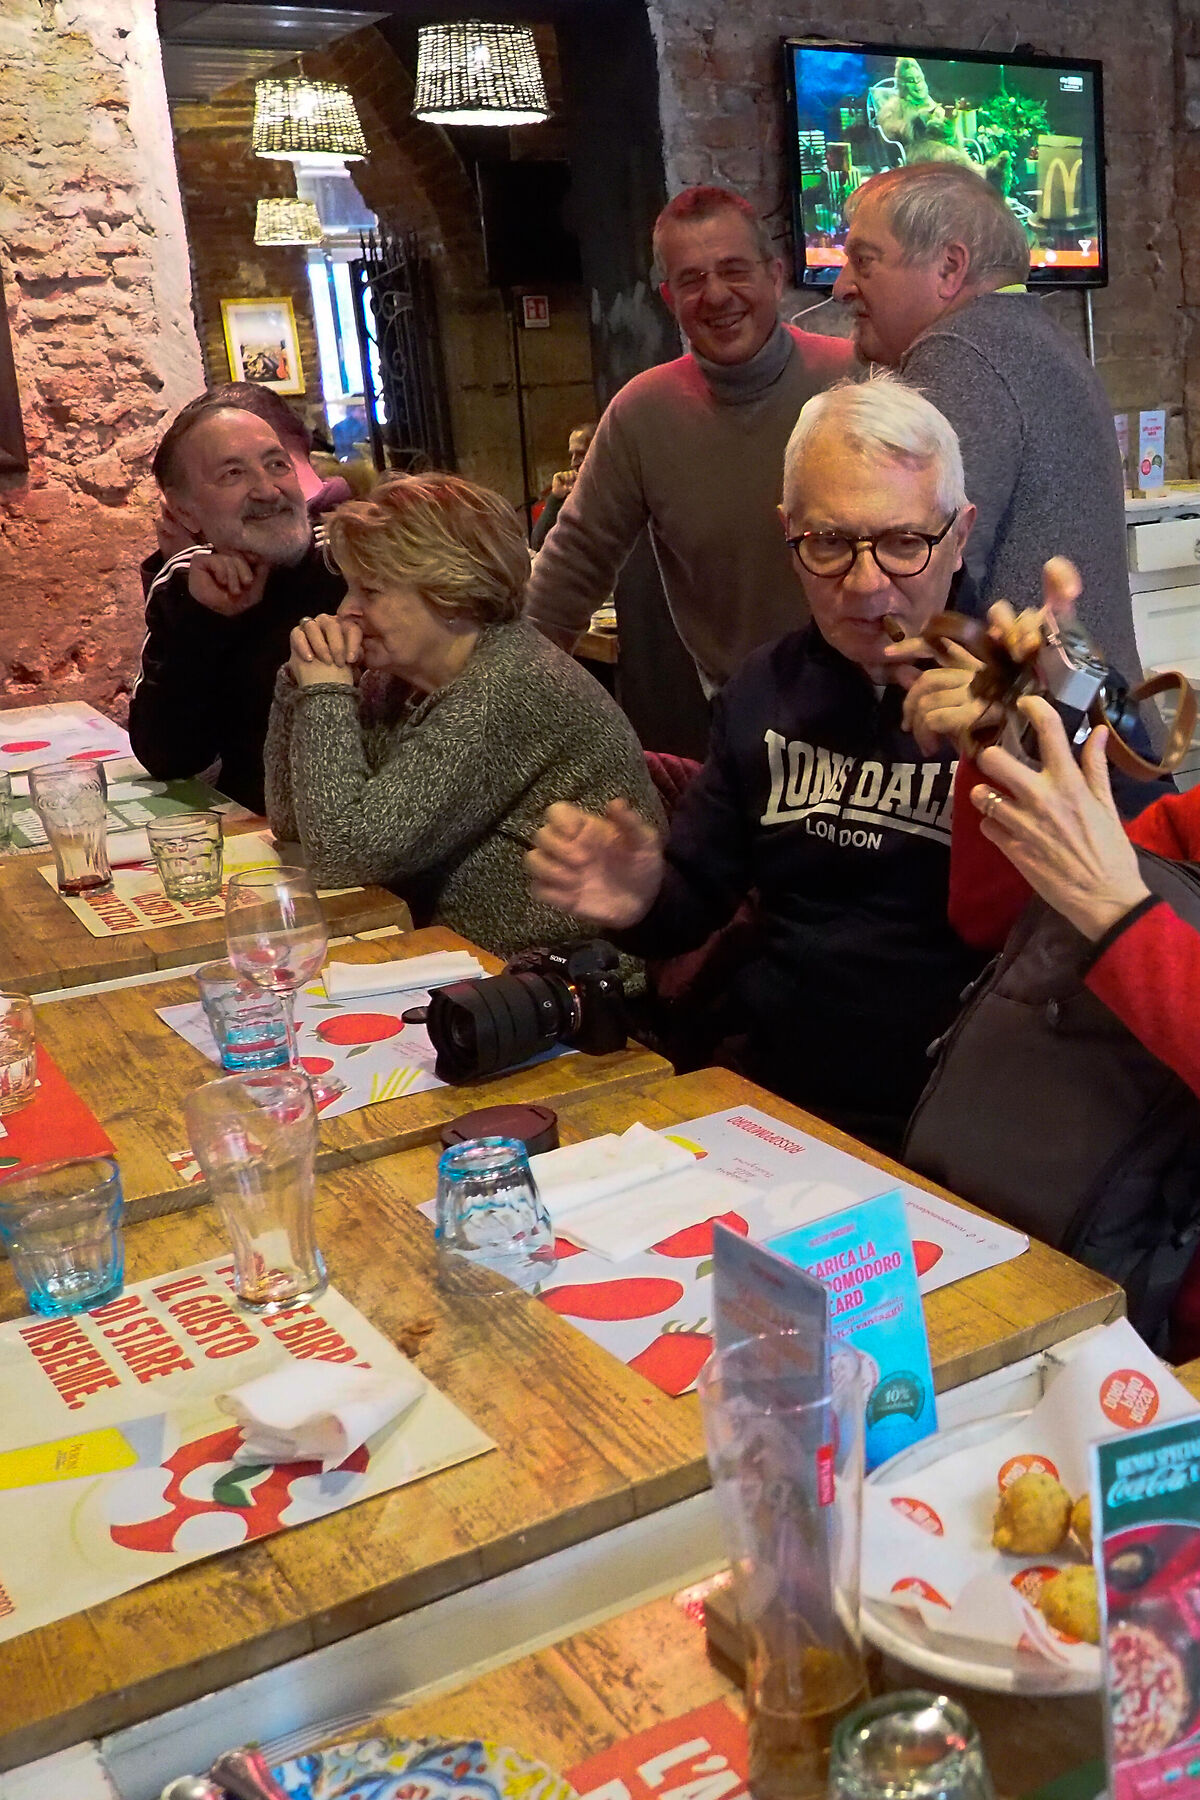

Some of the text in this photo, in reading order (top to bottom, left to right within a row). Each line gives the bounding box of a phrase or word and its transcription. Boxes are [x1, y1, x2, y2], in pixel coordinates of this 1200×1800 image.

[805, 817, 884, 851] LONDON
[130, 892, 180, 917] GUSTO
[549, 954, 567, 964] SONY
[806, 1250, 858, 1281] CARICA
[858, 1240, 876, 1261] LA
[152, 1275, 208, 1302] IL
[88, 1295, 196, 1384] DI STARE
[168, 1293, 261, 1360] GUSTO
[272, 1315, 373, 1369] BIRR
[18, 1316, 122, 1411] INSIEME.
